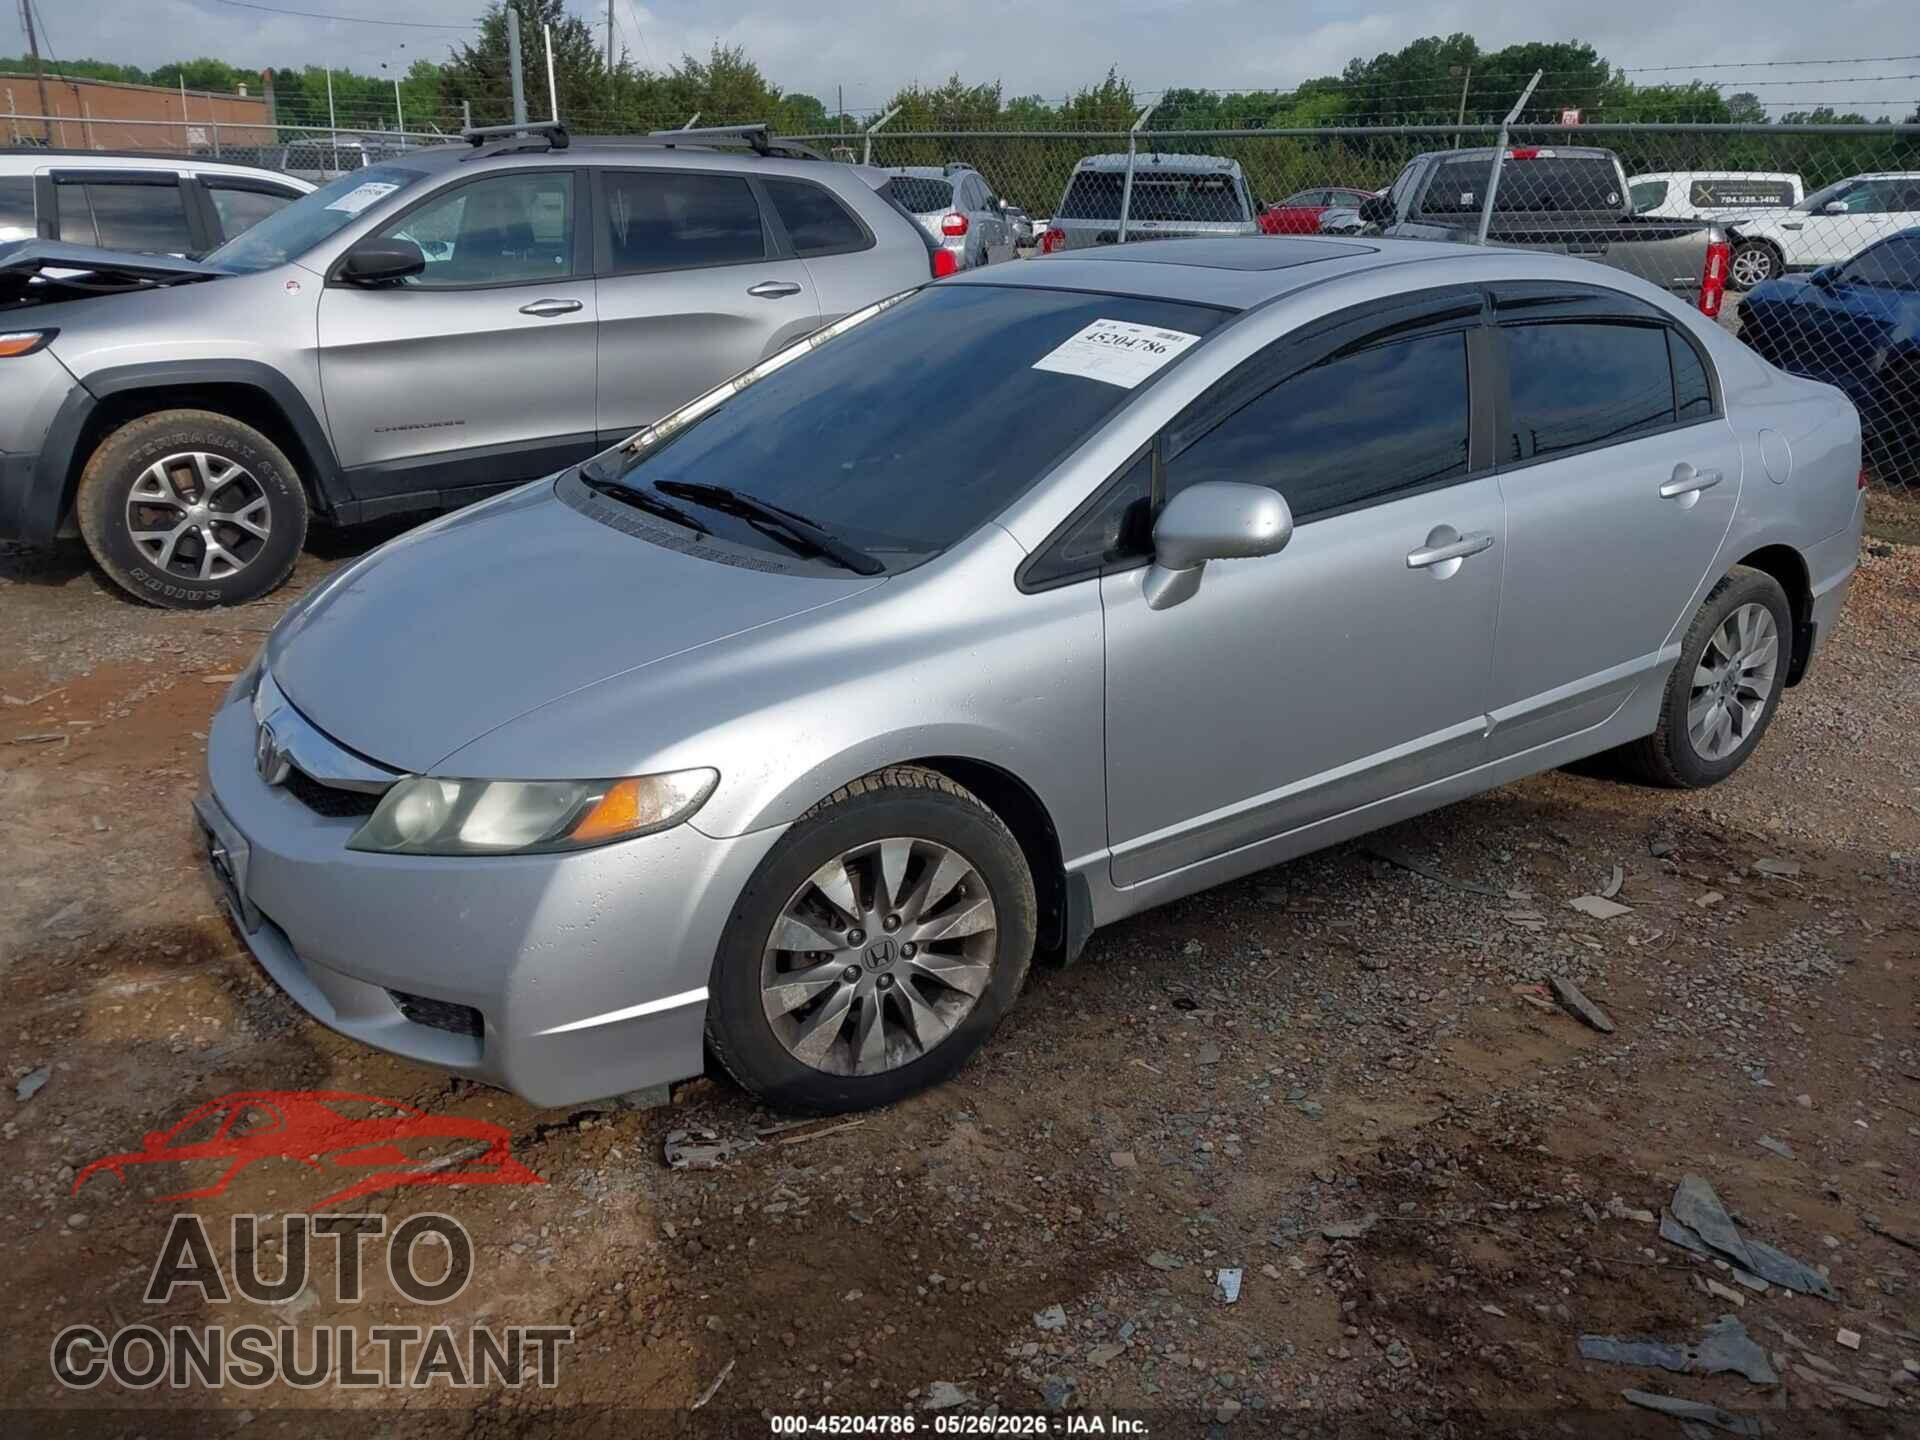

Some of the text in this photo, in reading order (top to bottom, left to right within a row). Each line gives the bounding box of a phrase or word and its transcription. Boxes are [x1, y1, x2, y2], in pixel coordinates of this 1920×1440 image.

[1086, 331, 1168, 355] 45204786
[374, 419, 465, 432] CHEROKEE
[128, 431, 257, 463] TERRAMAX
[128, 567, 222, 601] SAILUN
